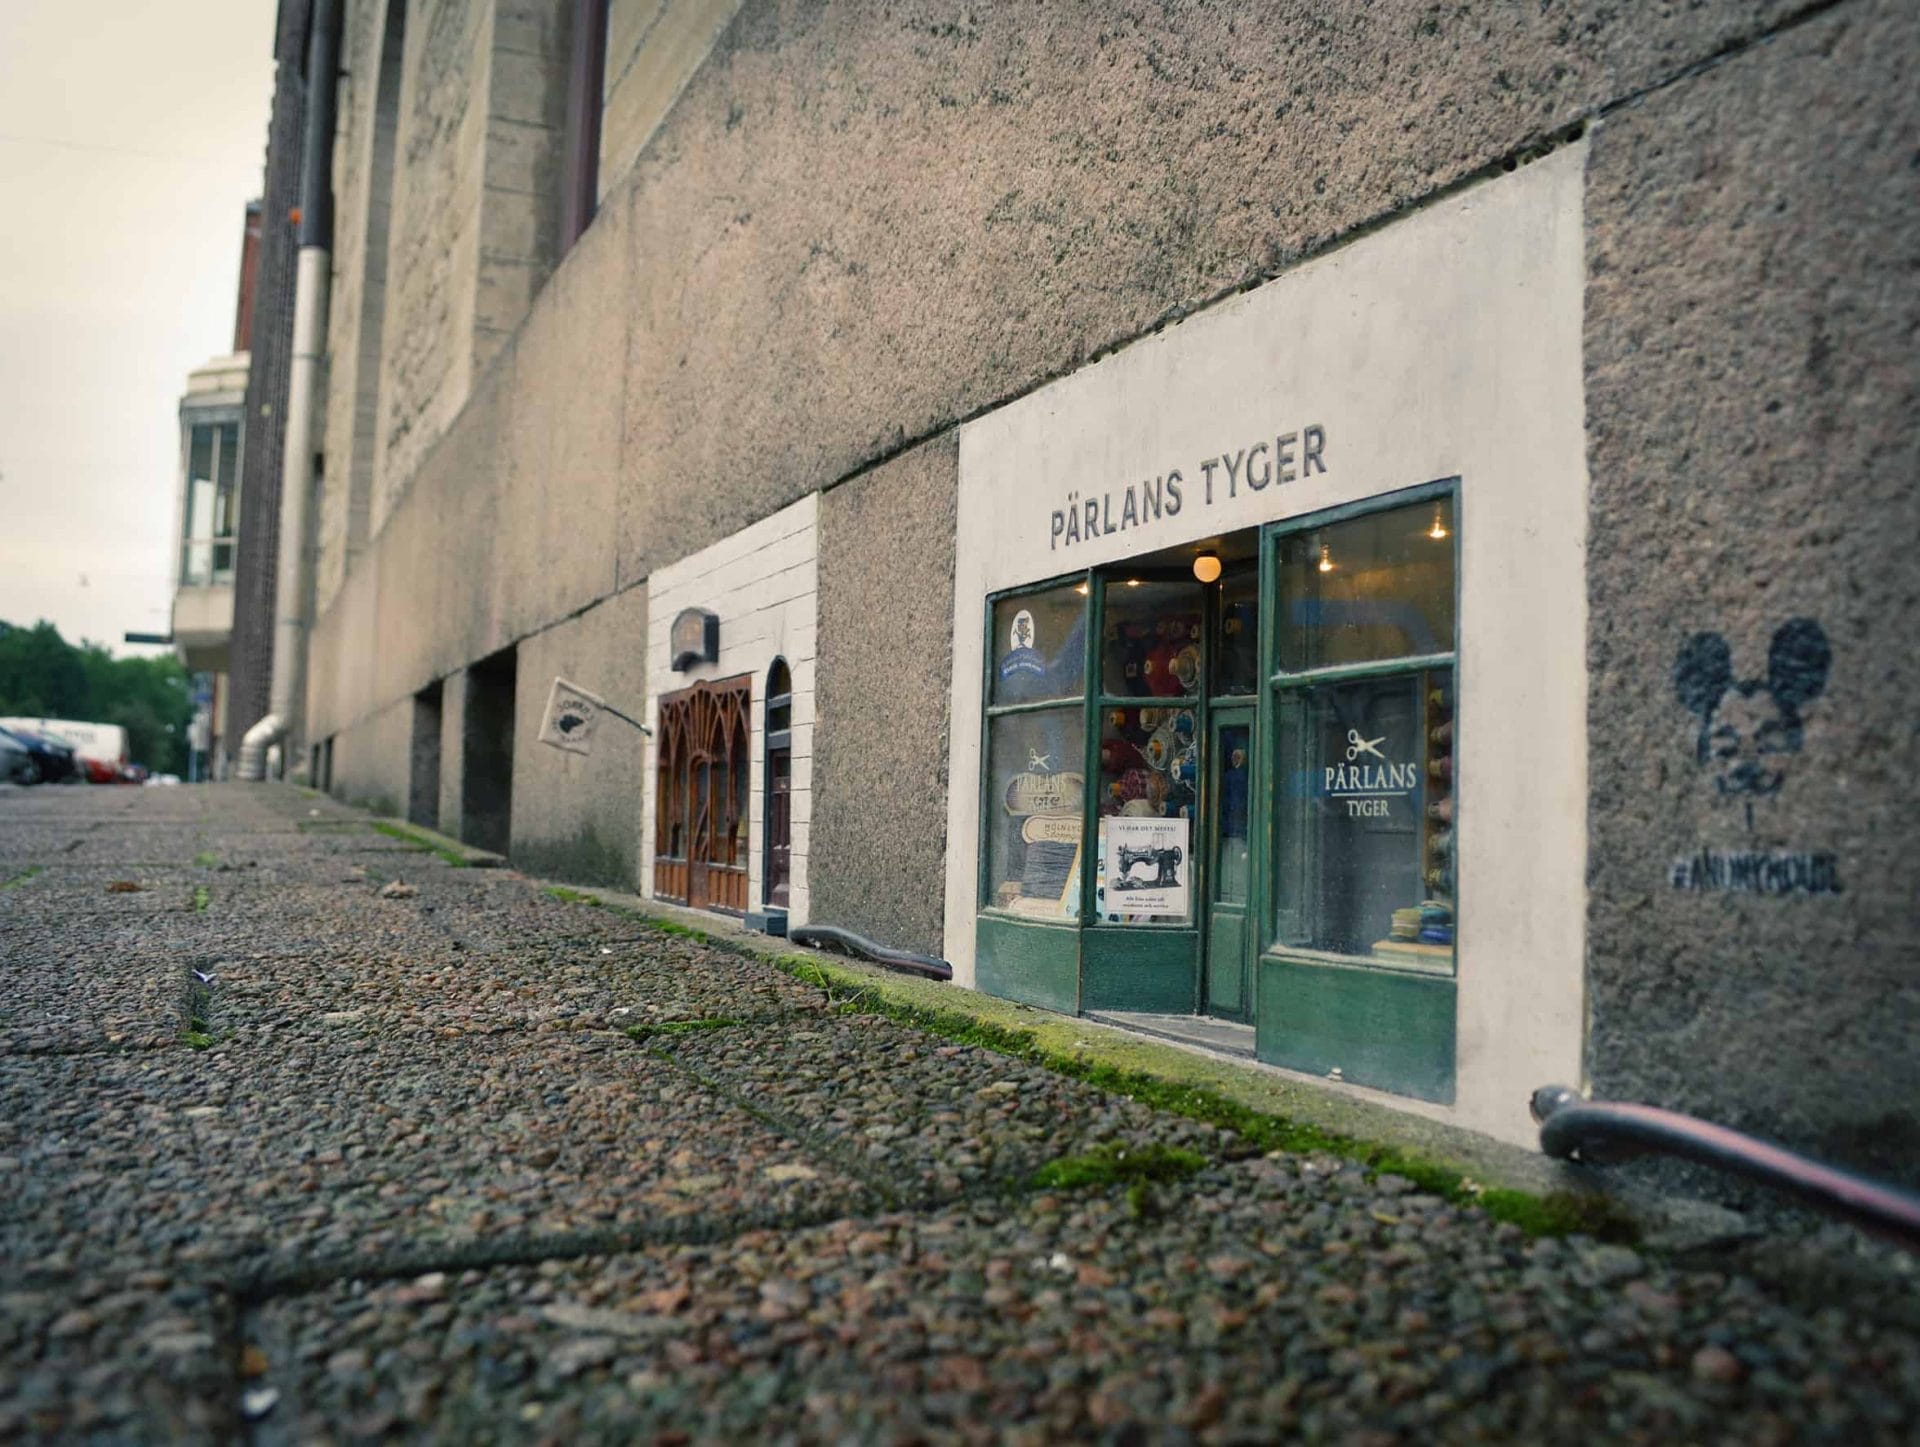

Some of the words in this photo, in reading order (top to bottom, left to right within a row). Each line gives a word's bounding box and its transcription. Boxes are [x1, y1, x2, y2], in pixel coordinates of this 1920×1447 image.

[1050, 469, 1183, 550] PÄRLANS
[1200, 423, 1328, 505] TYGER
[1325, 762, 1417, 790] PÄRLANS
[1346, 800, 1390, 816] TYGER
